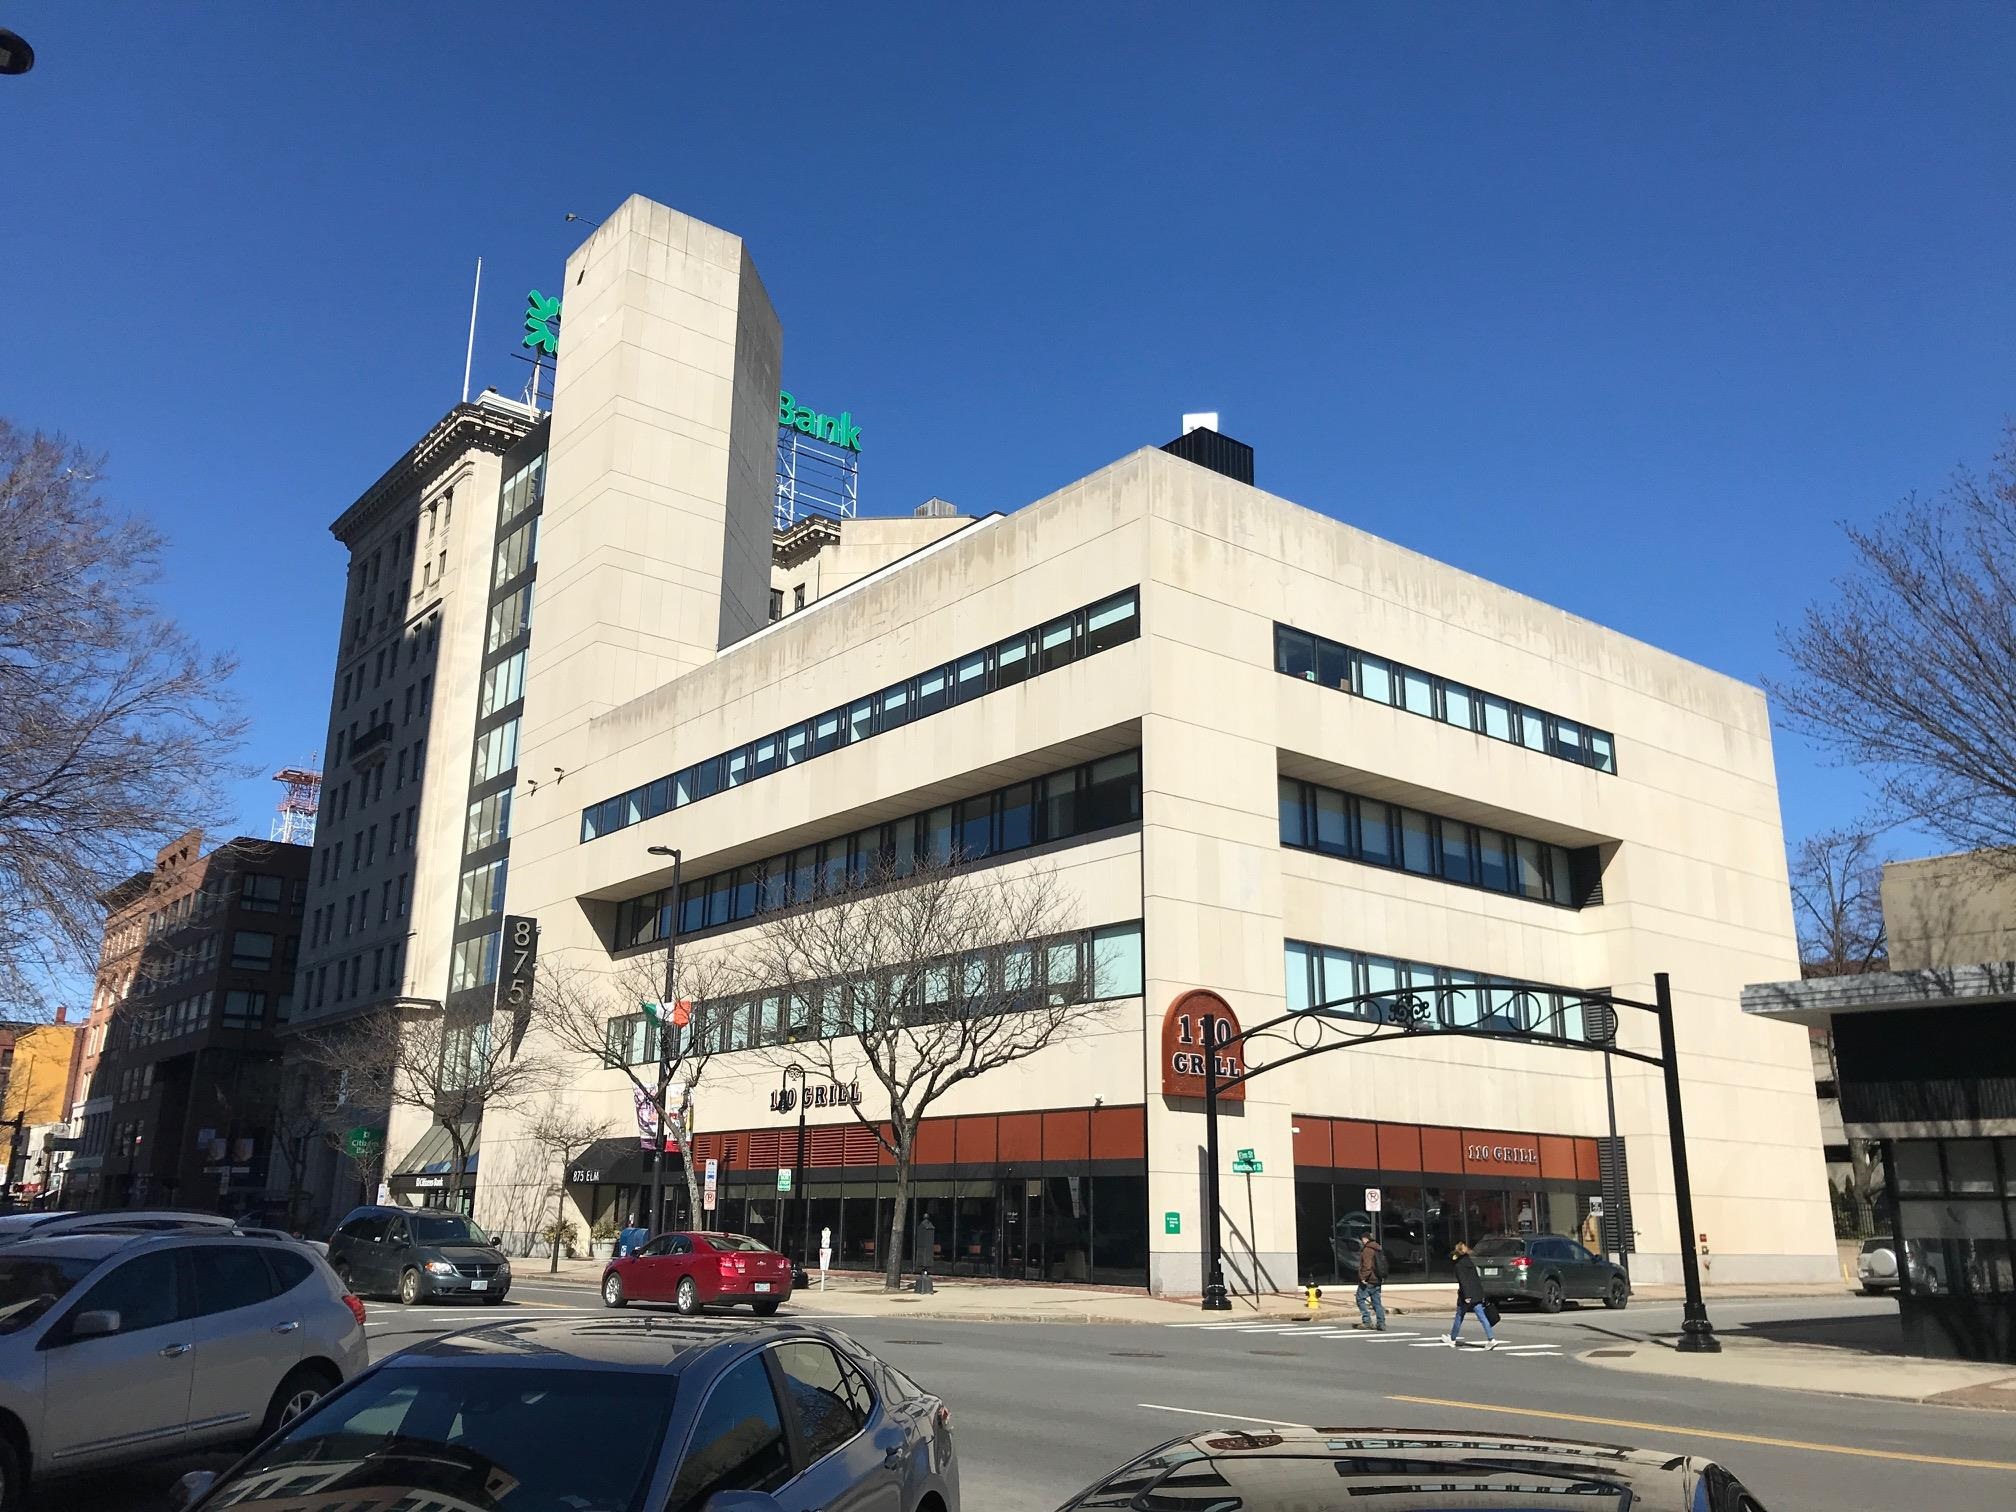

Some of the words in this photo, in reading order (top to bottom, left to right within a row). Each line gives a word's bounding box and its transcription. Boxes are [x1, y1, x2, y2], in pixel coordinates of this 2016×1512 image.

[779, 390, 863, 452] Bank
[508, 921, 531, 1005] 875
[1172, 1051, 1242, 1079] GRLL
[769, 1087, 798, 1111] 10
[803, 1082, 863, 1109] GRILL
[1468, 1145, 1489, 1161] 110
[1493, 1146, 1538, 1164] GRILL
[572, 1170, 585, 1182] 875
[585, 1170, 600, 1182] ELM
